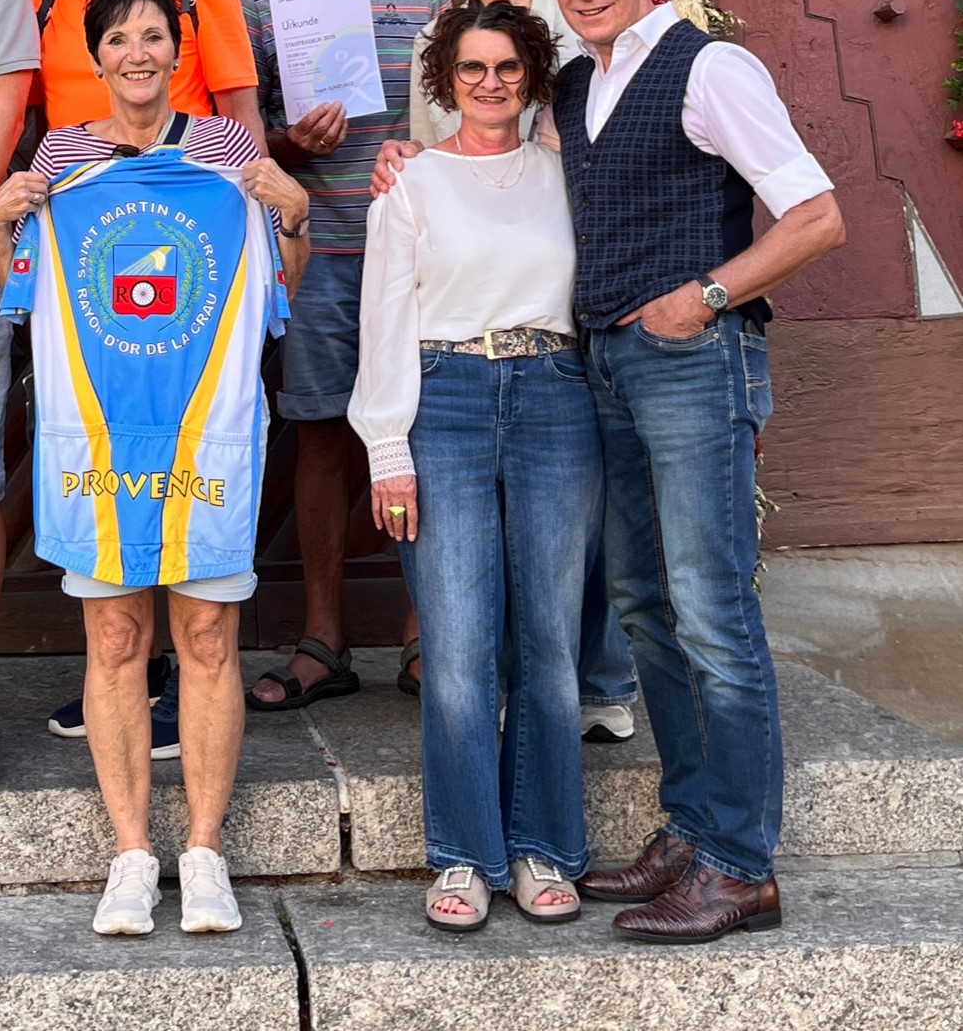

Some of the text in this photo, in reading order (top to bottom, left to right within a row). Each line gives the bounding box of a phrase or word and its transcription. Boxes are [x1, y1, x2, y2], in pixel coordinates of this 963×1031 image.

[282, 17, 319, 30] Urkunde
[78, 201, 219, 282] SAINT MARTIN DE CRAU
[103, 334, 141, 355] D'OR
[146, 341, 167, 355] DE
[171, 332, 191, 351] LA
[190, 292, 217, 335] CRAU
[61, 469, 226, 507] PROVENCE
